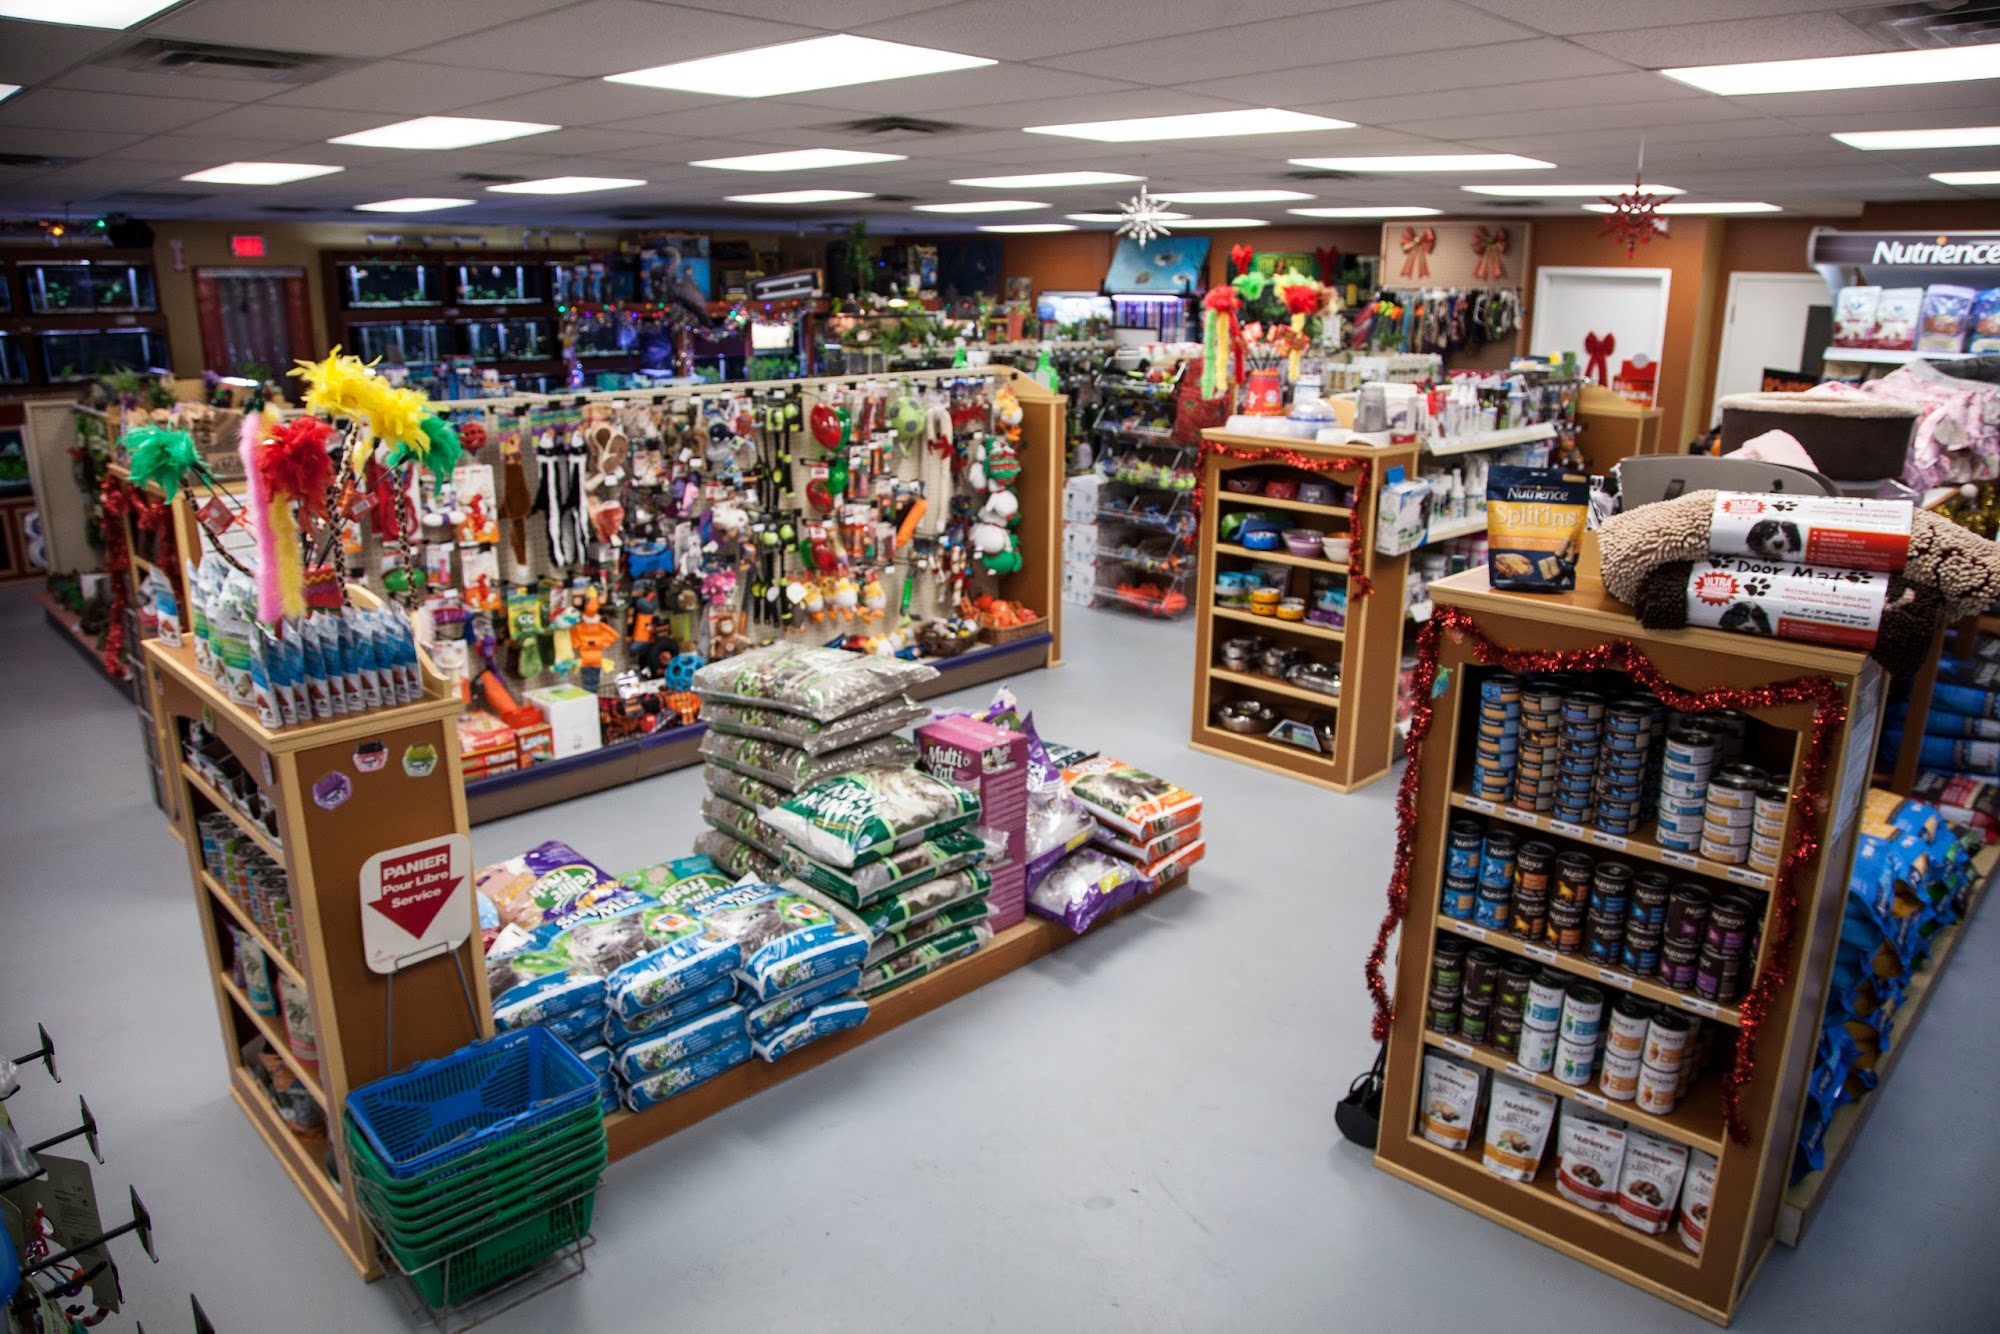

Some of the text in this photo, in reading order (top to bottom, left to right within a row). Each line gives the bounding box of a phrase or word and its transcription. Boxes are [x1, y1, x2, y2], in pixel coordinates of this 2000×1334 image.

[1873, 236, 2000, 264] Nutrience
[1507, 486, 1569, 501] Nutrience
[1704, 576, 1733, 588] ULTRA
[1737, 559, 1843, 592] Door Mat
[928, 745, 962, 768] Multi
[933, 763, 955, 780] Cat
[382, 853, 448, 881] PANIER
[382, 871, 449, 896] Pour Libre
[550, 871, 598, 902] Feline
[659, 877, 712, 906] Fresh
[391, 887, 442, 909] Service
[1434, 1072, 1467, 1090] Nutrience
[1503, 1099, 1541, 1117] Nutrience
[1573, 1132, 1611, 1151] Nutrience
[1633, 1149, 1673, 1166] Nutrience
